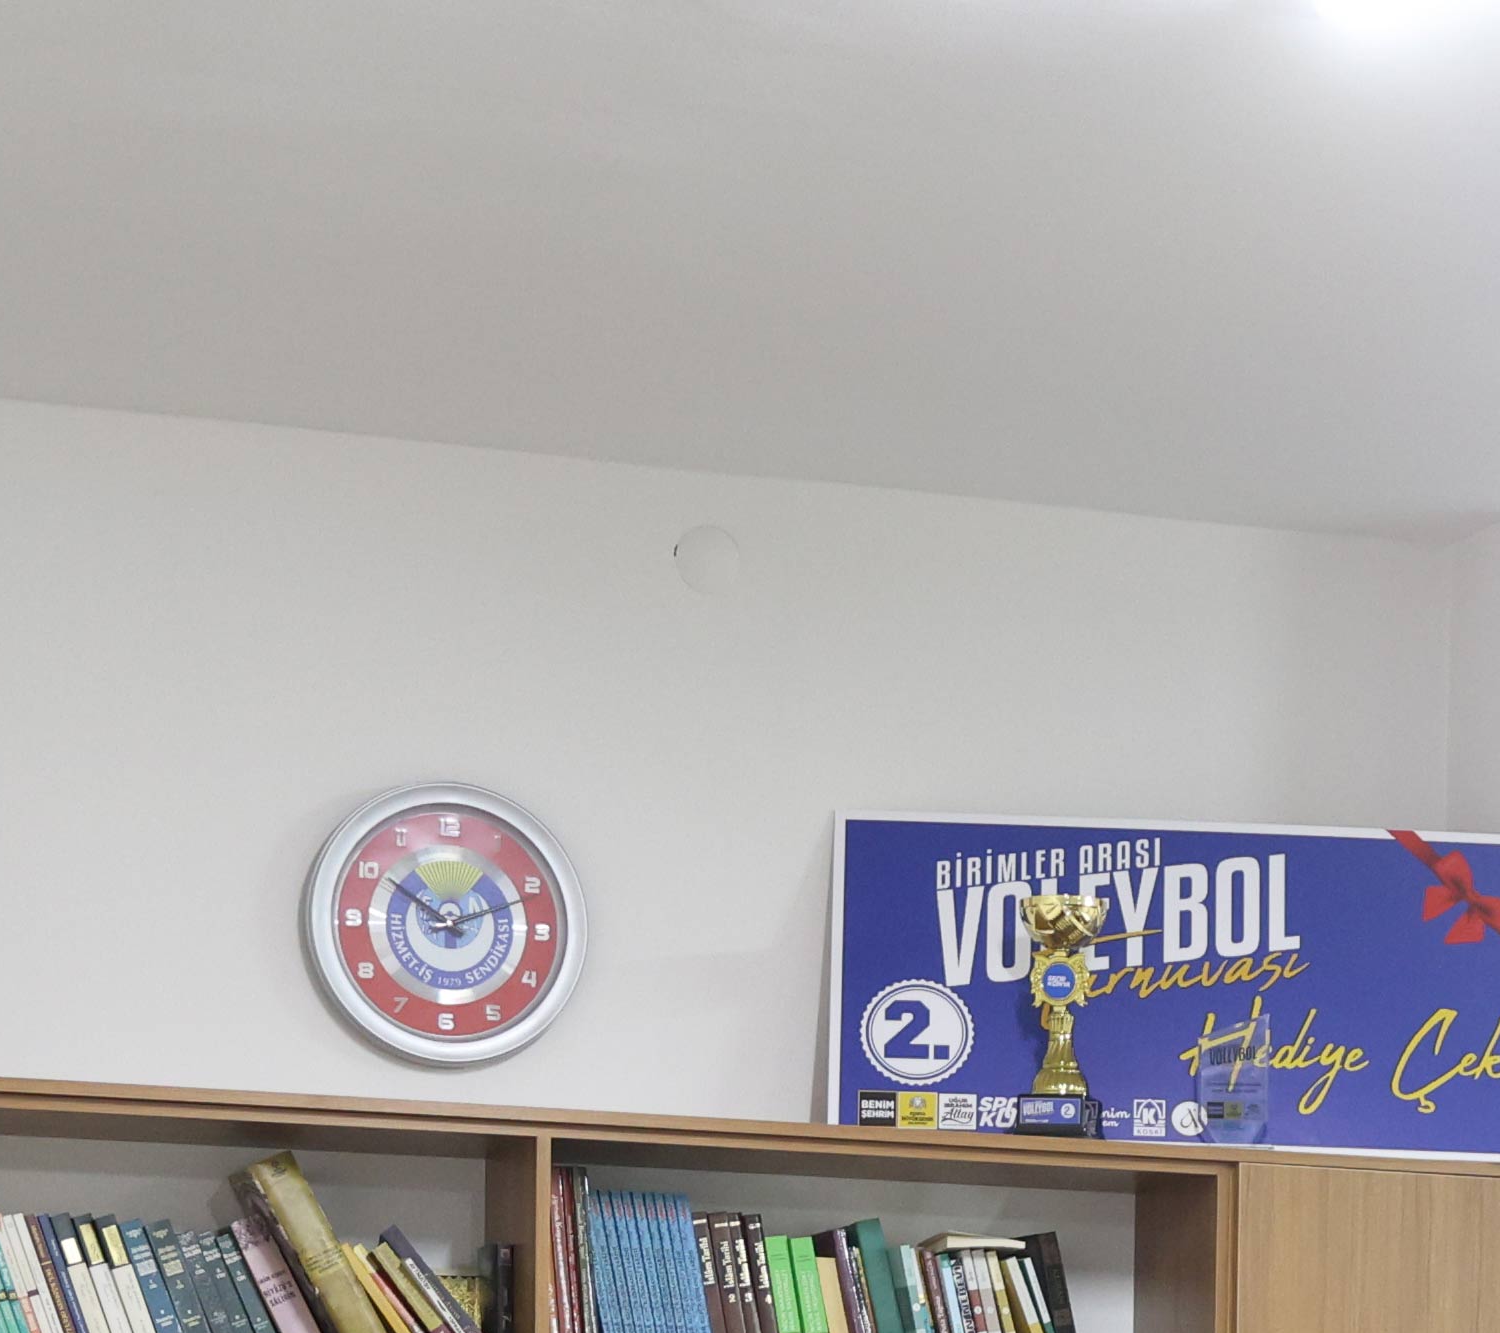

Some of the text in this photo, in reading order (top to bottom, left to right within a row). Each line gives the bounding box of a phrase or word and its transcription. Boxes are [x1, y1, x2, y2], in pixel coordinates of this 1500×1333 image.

[439, 817, 460, 837] 12
[358, 861, 379, 879] 10
[936, 837, 1162, 890] BİRİMLER ARASI
[525, 877, 540, 894] 2
[345, 909, 362, 927] 9
[936, 853, 1301, 987] VOEYBOL
[534, 924, 549, 941] 3
[390, 913, 433, 982] HİZMET-İŞ
[466, 918, 509, 985] SENDİKASI
[358, 963, 374, 979] 8
[521, 970, 536, 988] 4
[394, 997, 408, 1013] 7
[486, 1004, 501, 1021] 5
[438, 1013, 454, 1030] 6
[883, 1000, 949, 1060] 2.
[1180, 996, 1369, 1115] Hediye
[861, 1099, 894, 1109] BENİM
[861, 1109, 894, 1119] ŞEHRİM
